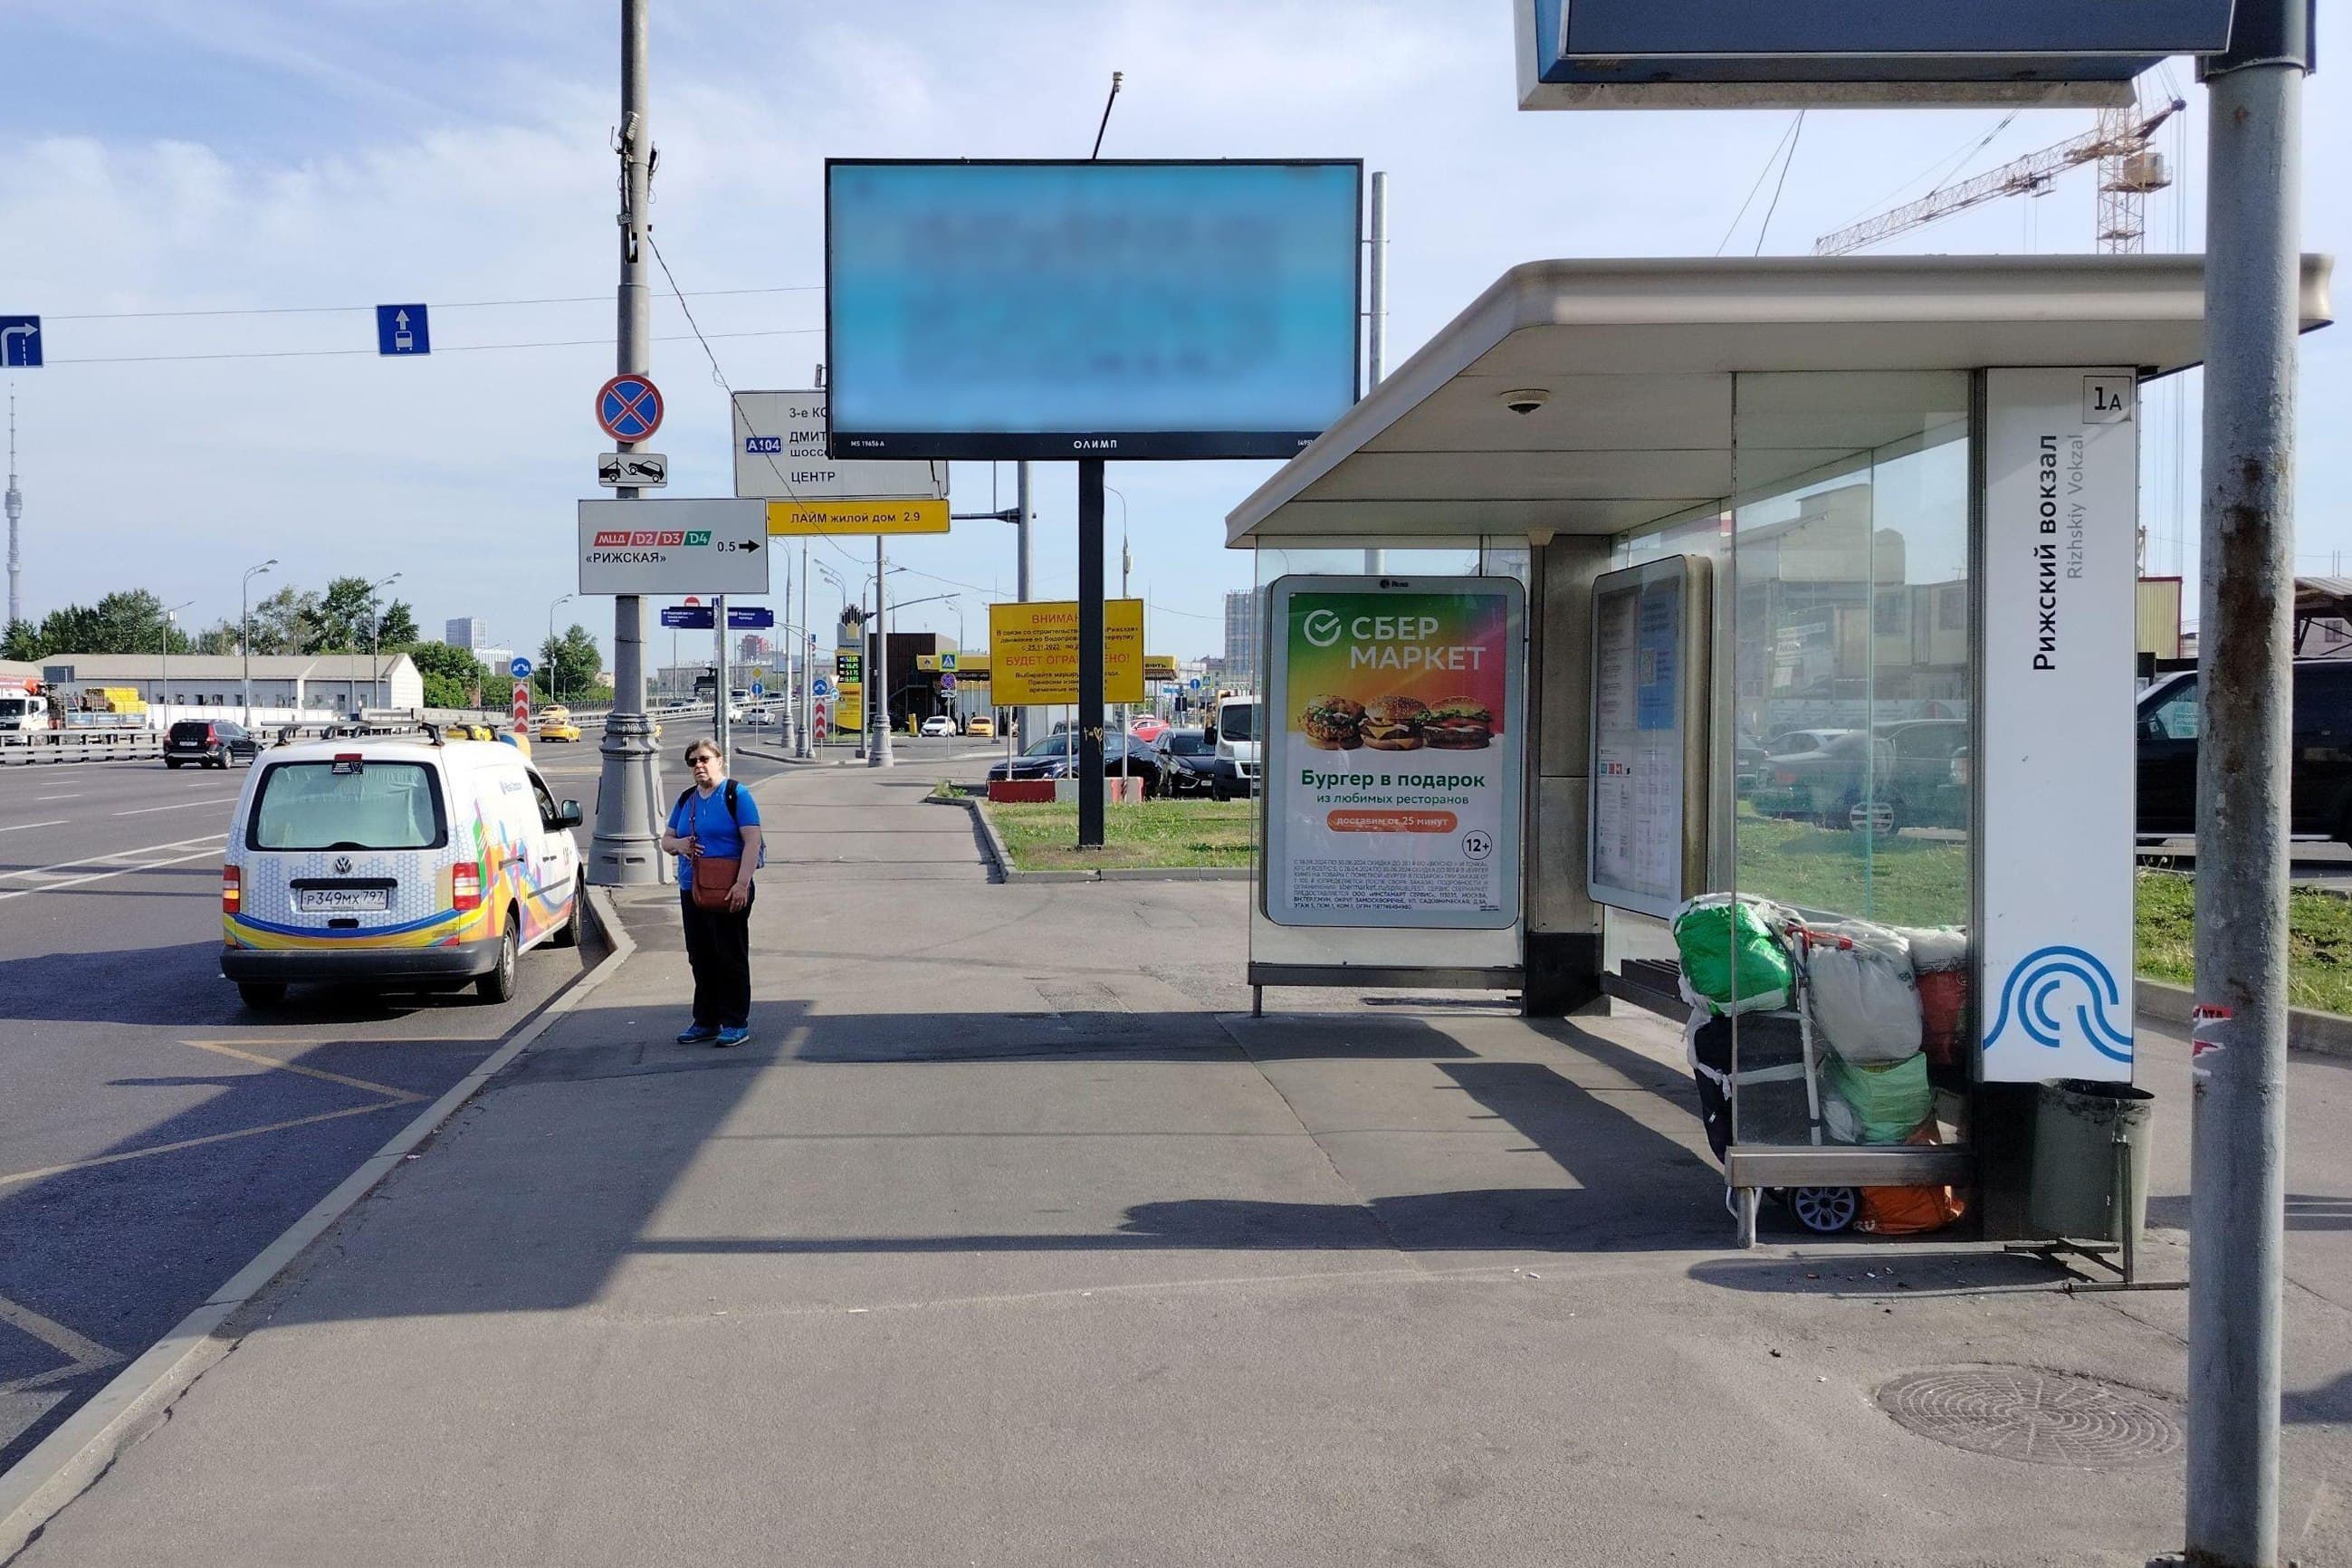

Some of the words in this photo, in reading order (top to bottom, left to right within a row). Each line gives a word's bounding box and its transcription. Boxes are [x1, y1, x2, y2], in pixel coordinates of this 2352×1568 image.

[789, 407, 808, 418] 3-е
[789, 431, 826, 444] ДМИТ
[1073, 439, 1117, 449] ОЛИМП
[789, 449, 825, 457] шосс
[2066, 435, 2084, 495] Vokzal
[791, 472, 835, 483] ЦЕНТР
[2040, 435, 2057, 534] вокзал
[790, 511, 827, 523] ЛАЙМ
[831, 512, 869, 523] жилой
[872, 513, 896, 523] дом
[904, 512, 921, 522] 2.9
[636, 536, 653, 545] D2
[663, 536, 680, 544] D3
[717, 541, 736, 552] 0.5
[2066, 503, 2087, 579] Rizhskiy
[586, 552, 666, 563] «РИЖСКАЯ»
[2033, 544, 2057, 671] Рижский
[1351, 616, 1439, 641] СБЕР
[1007, 655, 1043, 666] БУДЕТ
[1351, 645, 1487, 670] МАРКЕТ
[1302, 770, 1374, 789] Бургер
[1381, 775, 1391, 786] в
[1398, 774, 1486, 791] подарок
[1316, 795, 1330, 803] из
[1334, 793, 1392, 804] любимых
[1396, 796, 1469, 806] ресторанов
[1336, 817, 1385, 826] доставим
[1402, 817, 1414, 825] 25
[1417, 818, 1448, 827] минут
[1467, 838, 1489, 852] 12+
